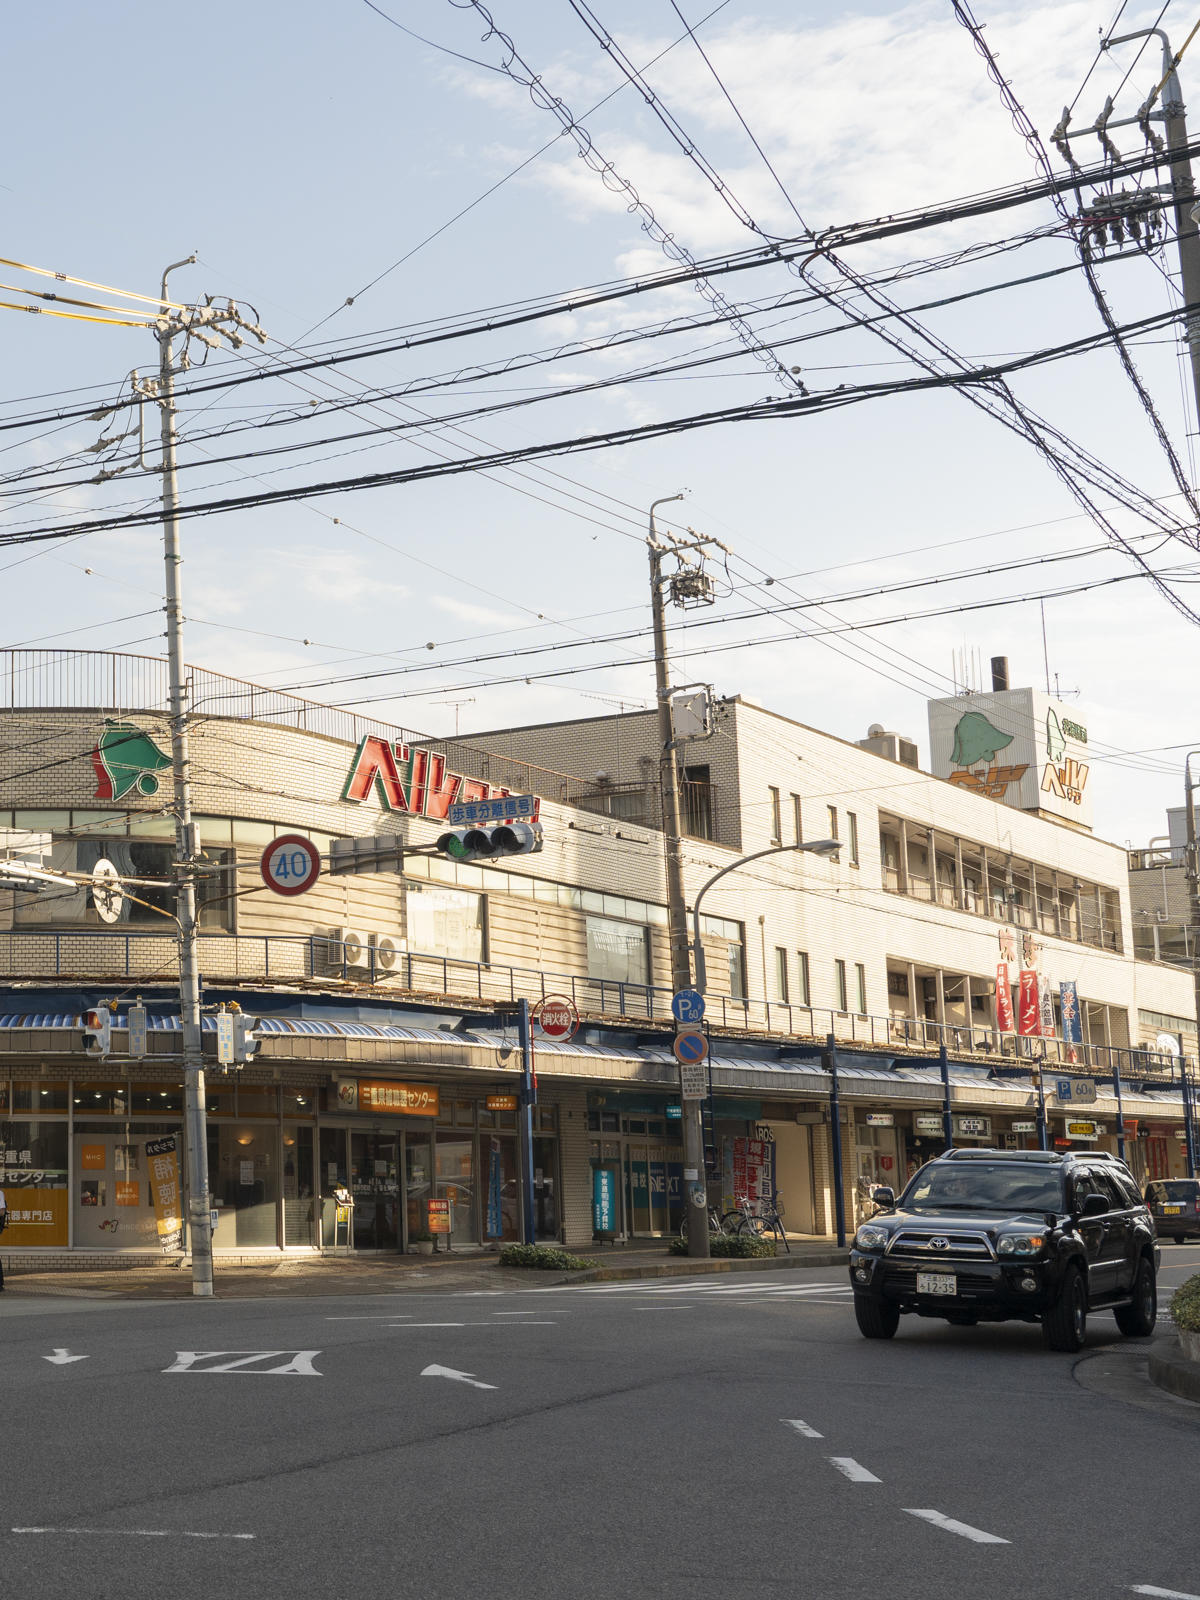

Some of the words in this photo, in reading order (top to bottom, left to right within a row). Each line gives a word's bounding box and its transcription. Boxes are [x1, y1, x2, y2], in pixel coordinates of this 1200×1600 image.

[452, 799, 531, 821] 歩車分離信号
[275, 852, 307, 879] 40
[678, 999, 692, 1020] P
[1022, 974, 1038, 1034] ラーメン
[542, 1012, 569, 1026] 消火栓
[1061, 1083, 1069, 1093] P
[927, 1282, 955, 1293] 12-35
